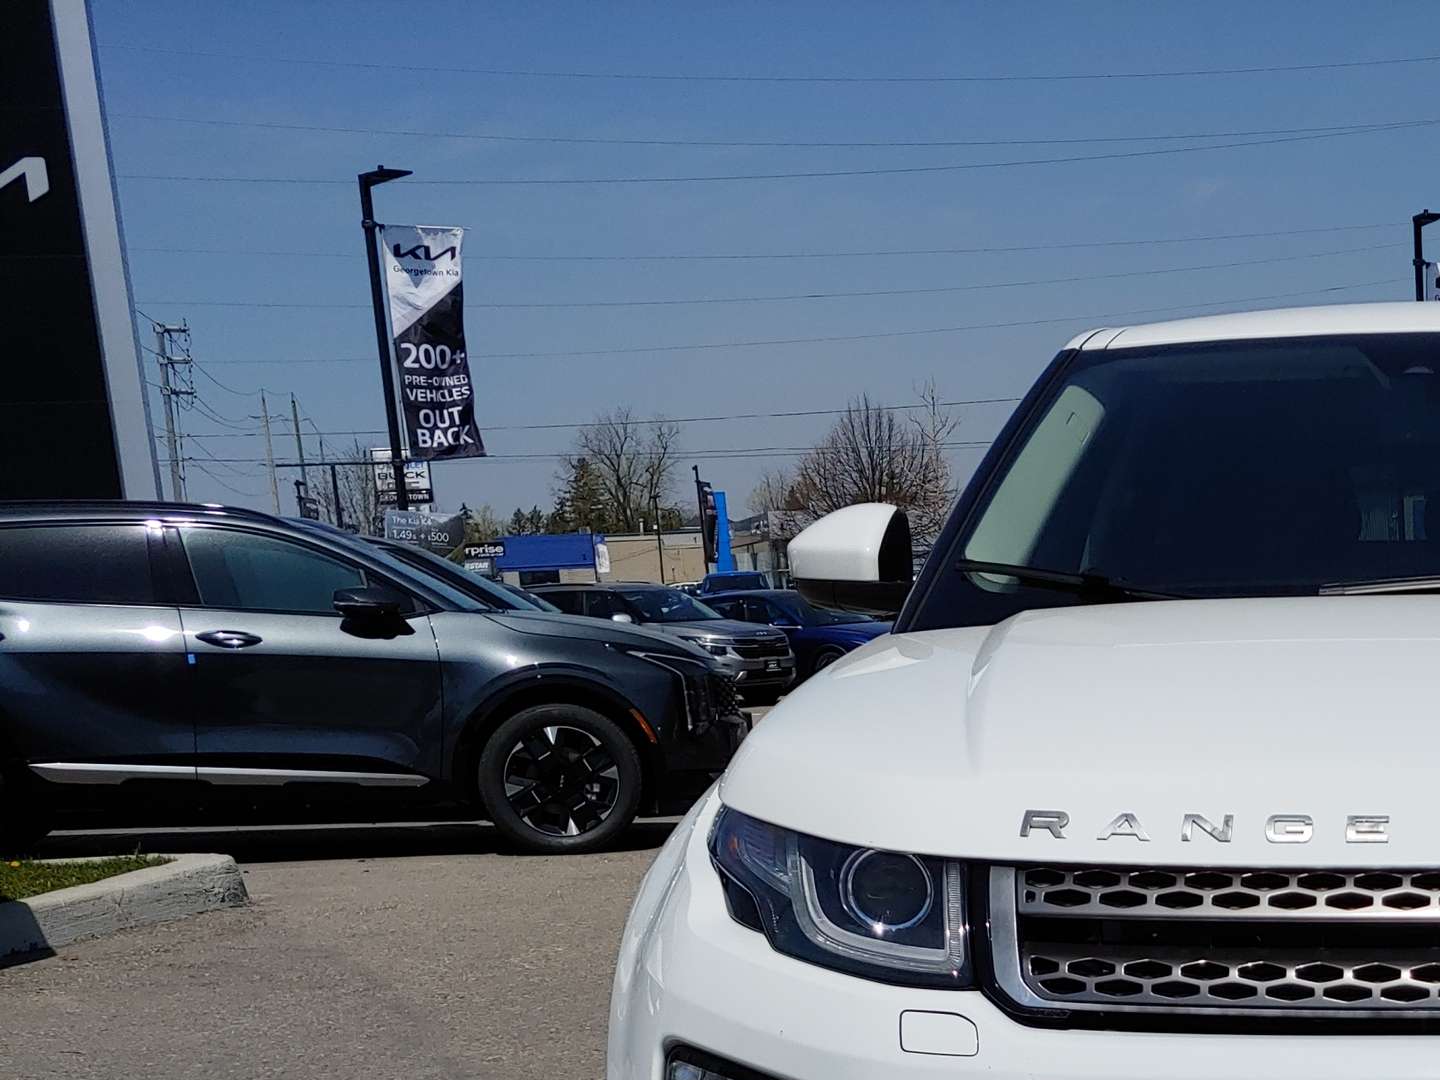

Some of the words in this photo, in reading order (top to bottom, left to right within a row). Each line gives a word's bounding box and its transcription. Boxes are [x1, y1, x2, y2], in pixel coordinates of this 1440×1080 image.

[393, 243, 457, 261] KIA
[446, 268, 459, 277] Kia
[400, 342, 465, 370] 200+
[406, 386, 471, 402] VEHICLES
[419, 406, 462, 428] OUT
[416, 424, 475, 448] BACK
[464, 545, 504, 557] rprise
[1019, 809, 1391, 844] RANGE
